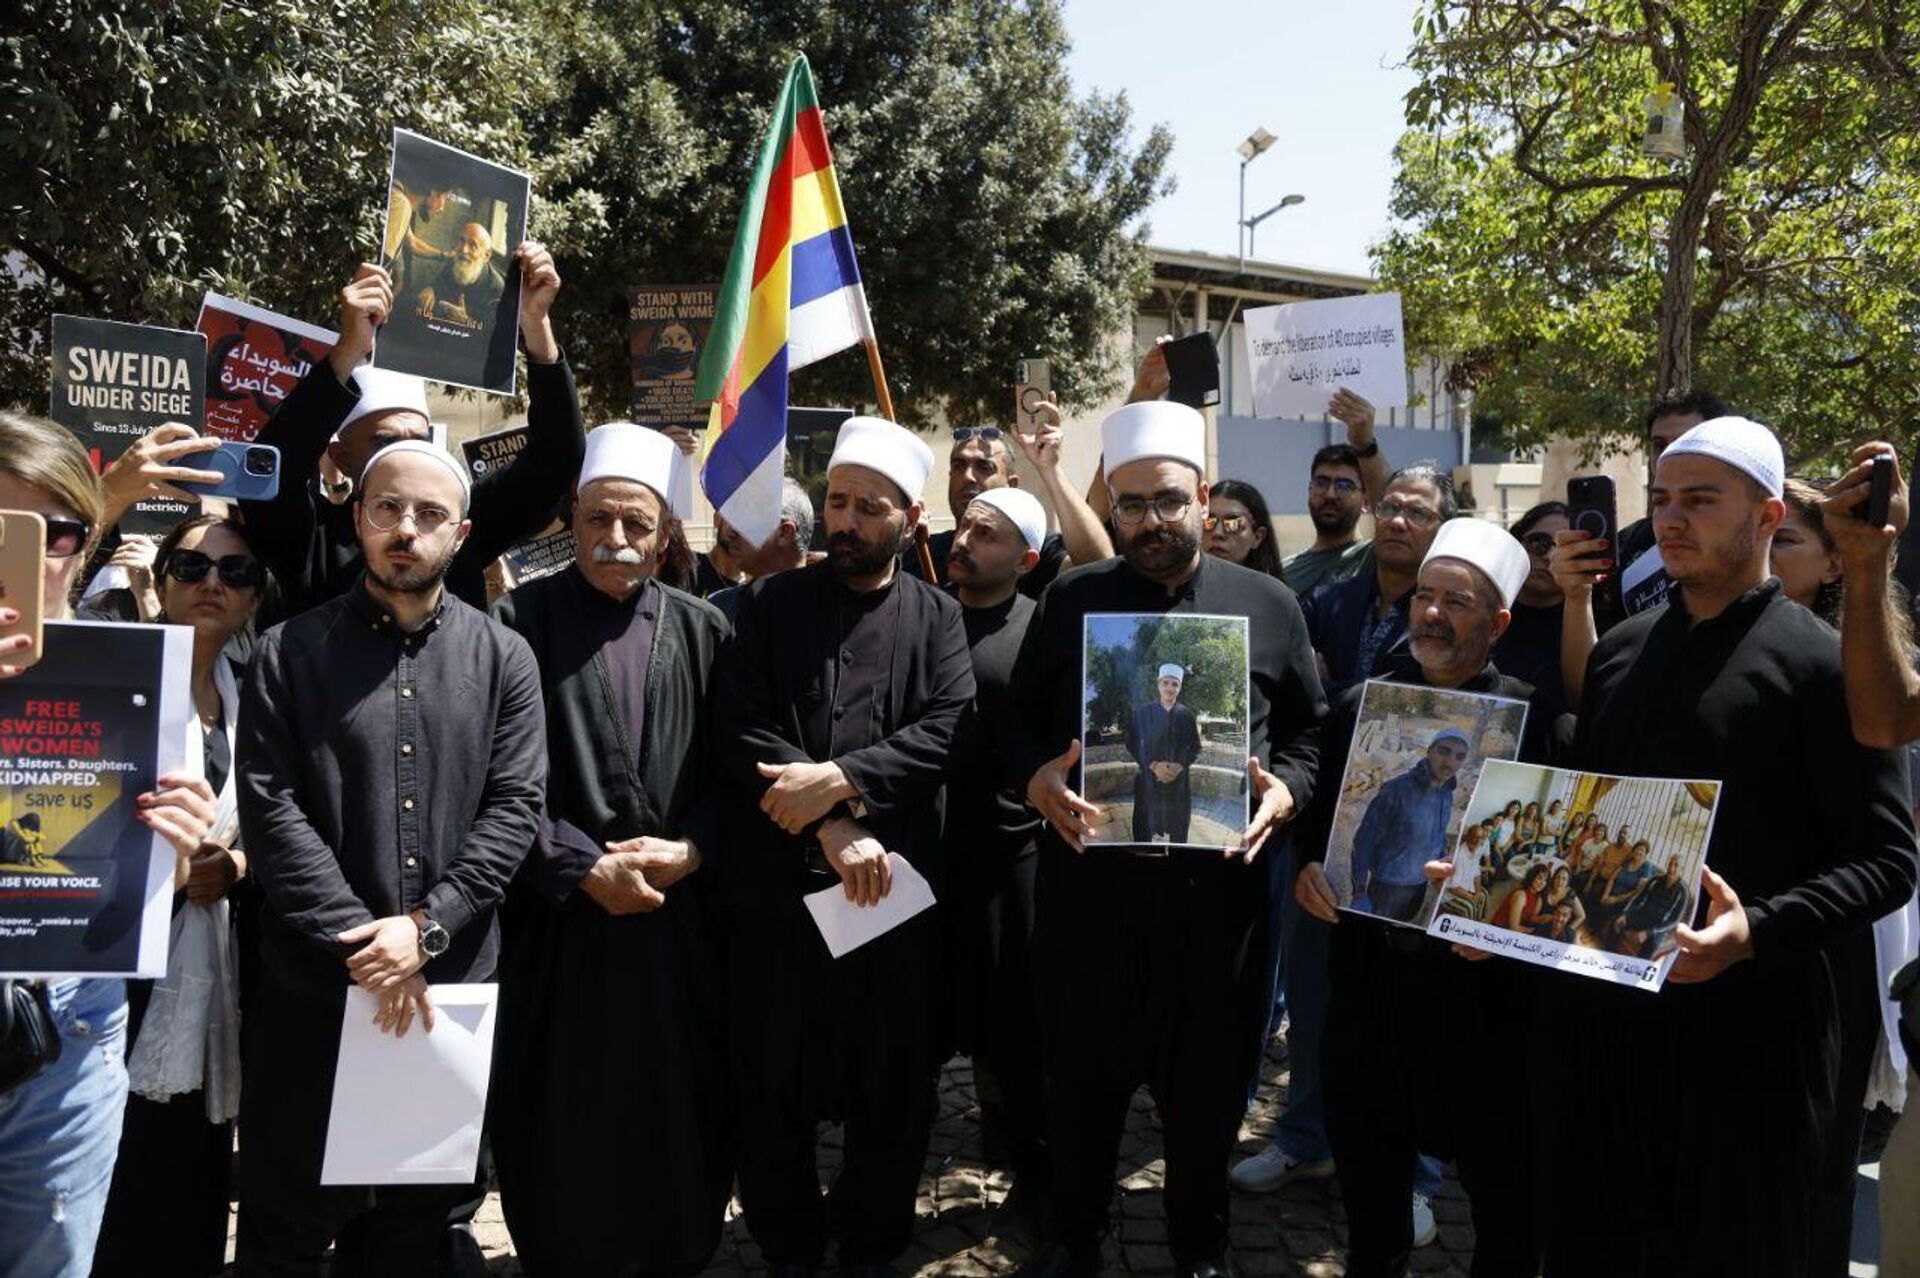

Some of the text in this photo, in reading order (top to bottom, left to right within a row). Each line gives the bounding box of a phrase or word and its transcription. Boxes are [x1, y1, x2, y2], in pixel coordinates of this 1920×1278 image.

[638, 292, 712, 306] STAND WITH
[630, 305, 716, 320] SWEIDA WOME
[68, 346, 191, 391] SWEIDA
[228, 343, 312, 378] السويداء
[221, 365, 289, 400] حاصرة
[68, 384, 191, 415] UNDER SIEGE
[93, 422, 117, 434] Since
[118, 424, 129, 434] 13
[130, 425, 147, 437] July
[480, 434, 527, 460] STAND
[136, 502, 189, 514] Electricity
[26, 701, 81, 718] FREE
[0, 720, 102, 737] SWEIDA'S
[0, 738, 100, 756] WOMEN
[18, 758, 65, 770] Sisters.
[68, 760, 138, 772] Daughters.
[25, 793, 93, 809] save us
[24, 878, 58, 888] YOUR
[61, 878, 102, 888] VOICE.
